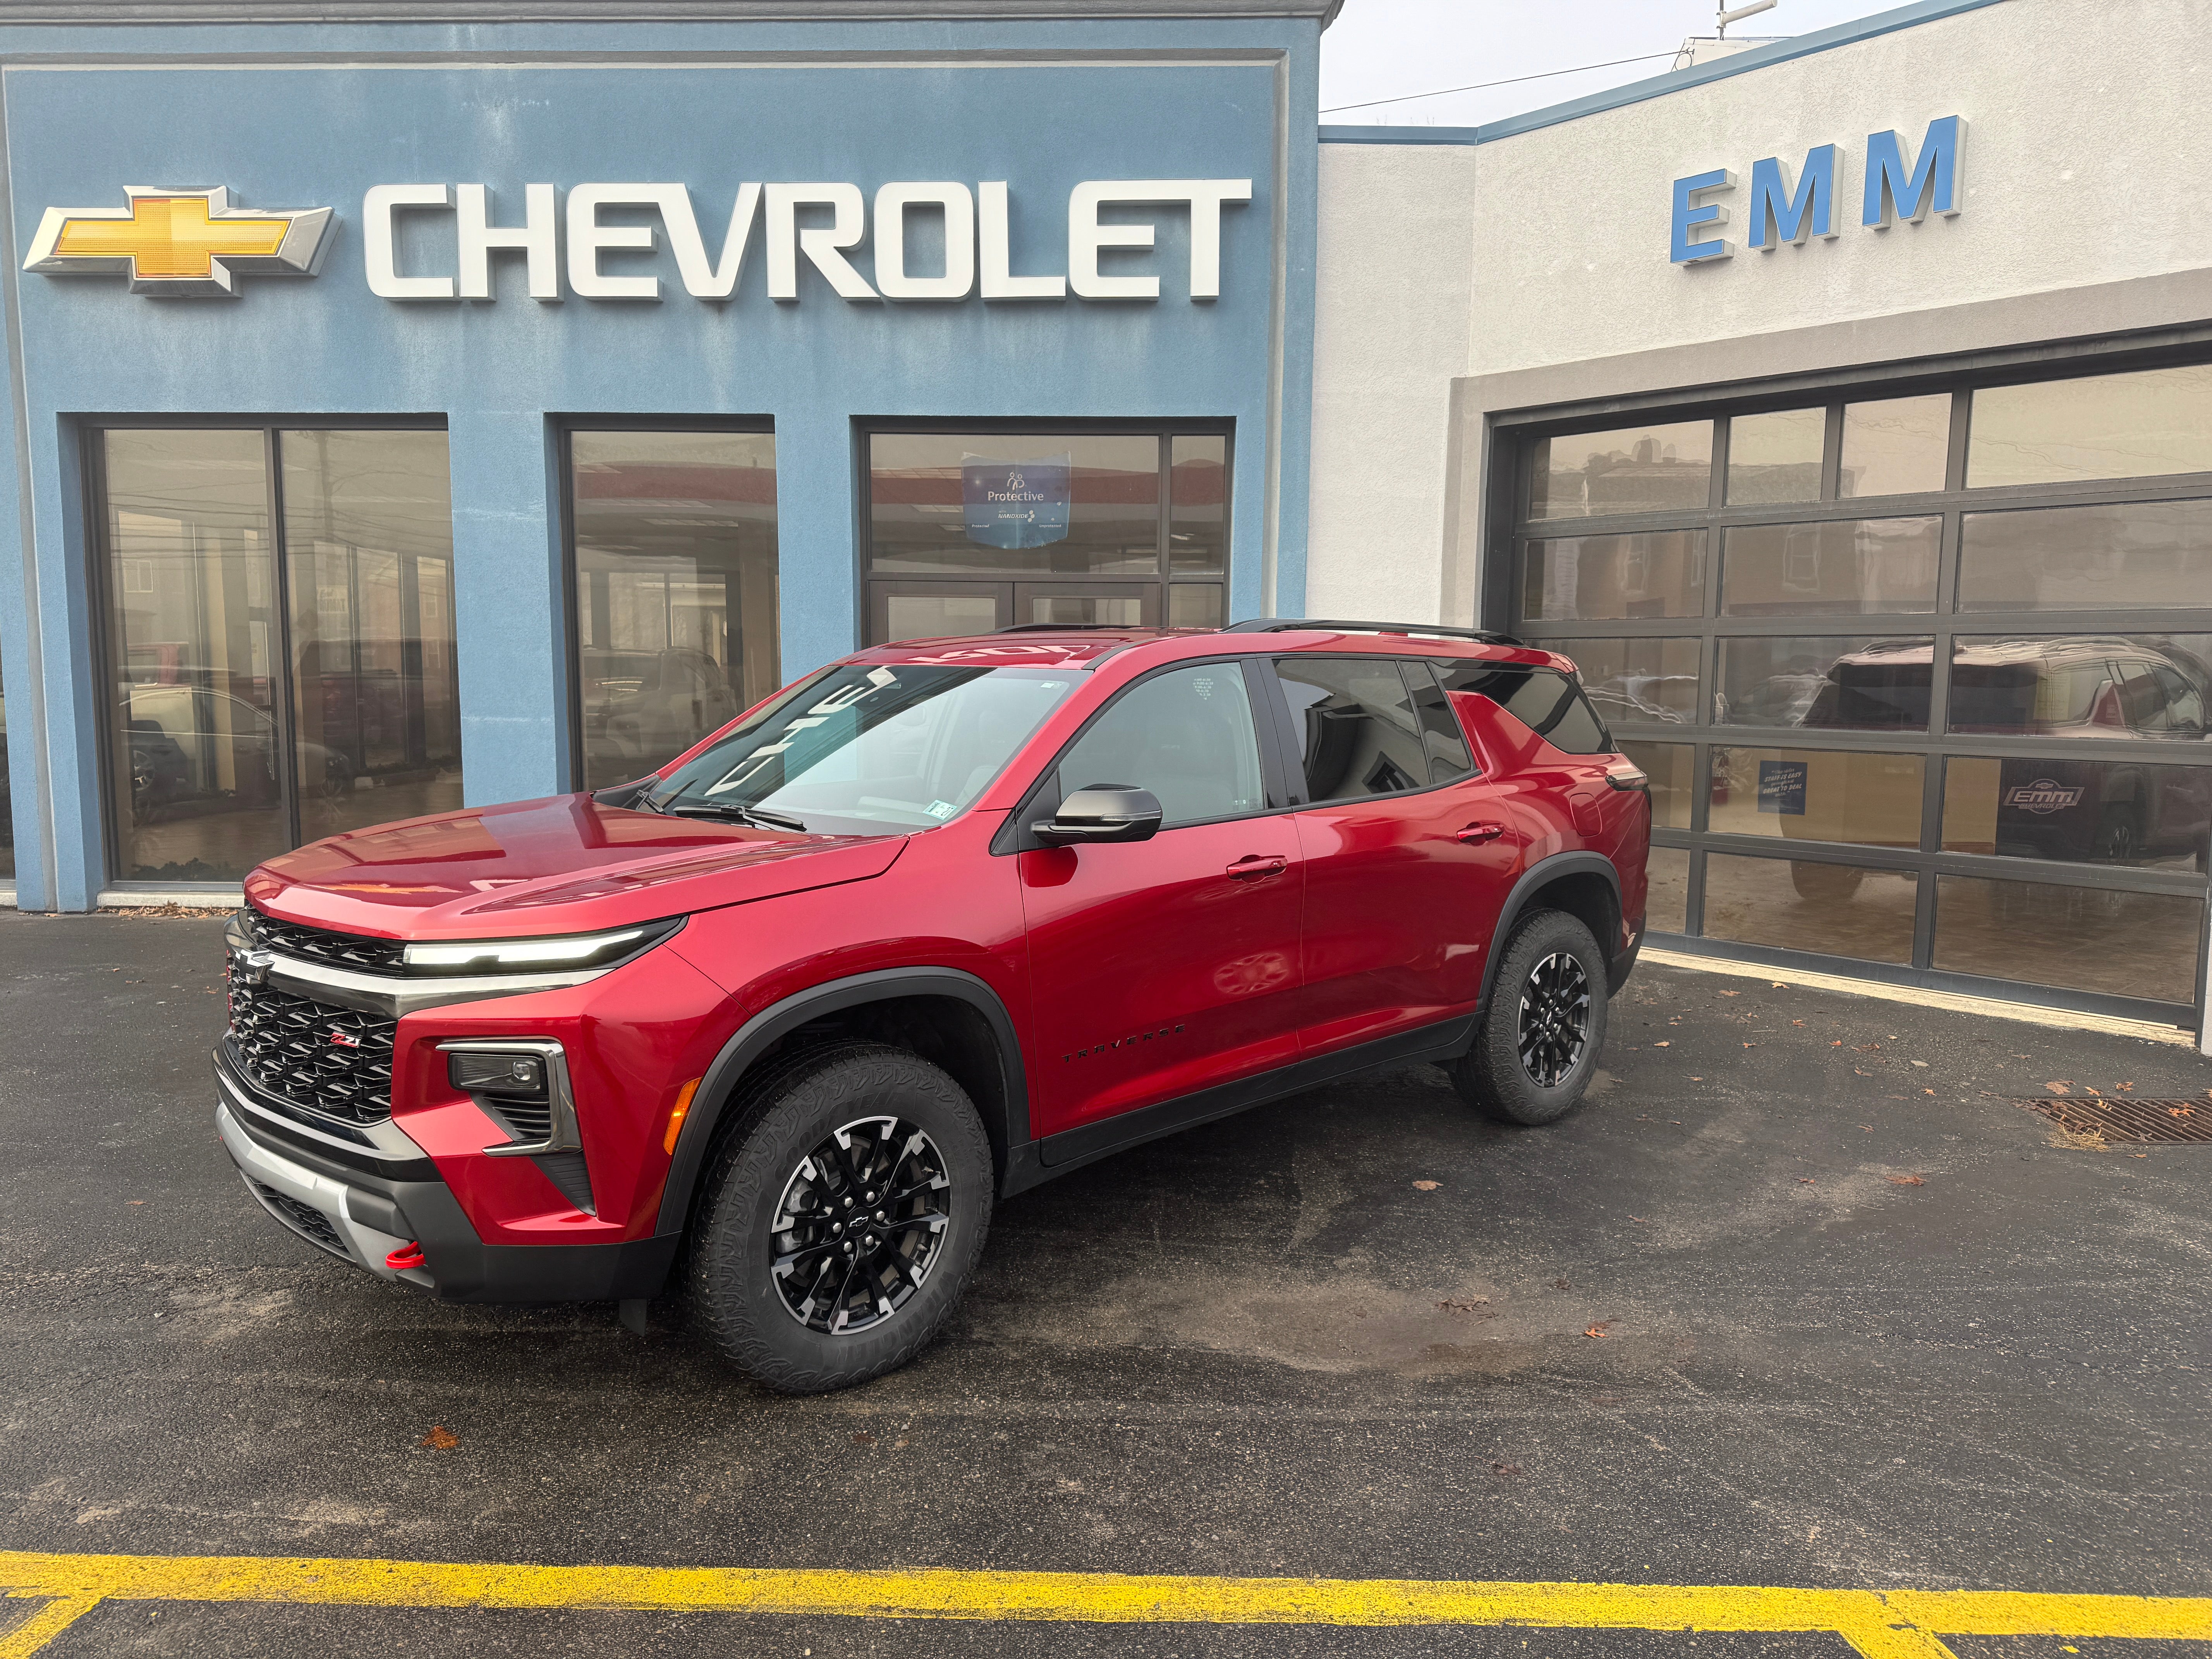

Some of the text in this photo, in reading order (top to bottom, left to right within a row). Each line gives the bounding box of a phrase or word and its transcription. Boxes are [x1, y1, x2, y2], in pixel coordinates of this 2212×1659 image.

[1670, 115, 1968, 266] EMM
[363, 178, 1252, 301] CHEVROLET
[988, 491, 1044, 501] Protective
[330, 1031, 362, 1048] Z71
[1061, 1024, 1186, 1063] TRAVERSE
[775, 1091, 905, 1182] GOODYEAR
